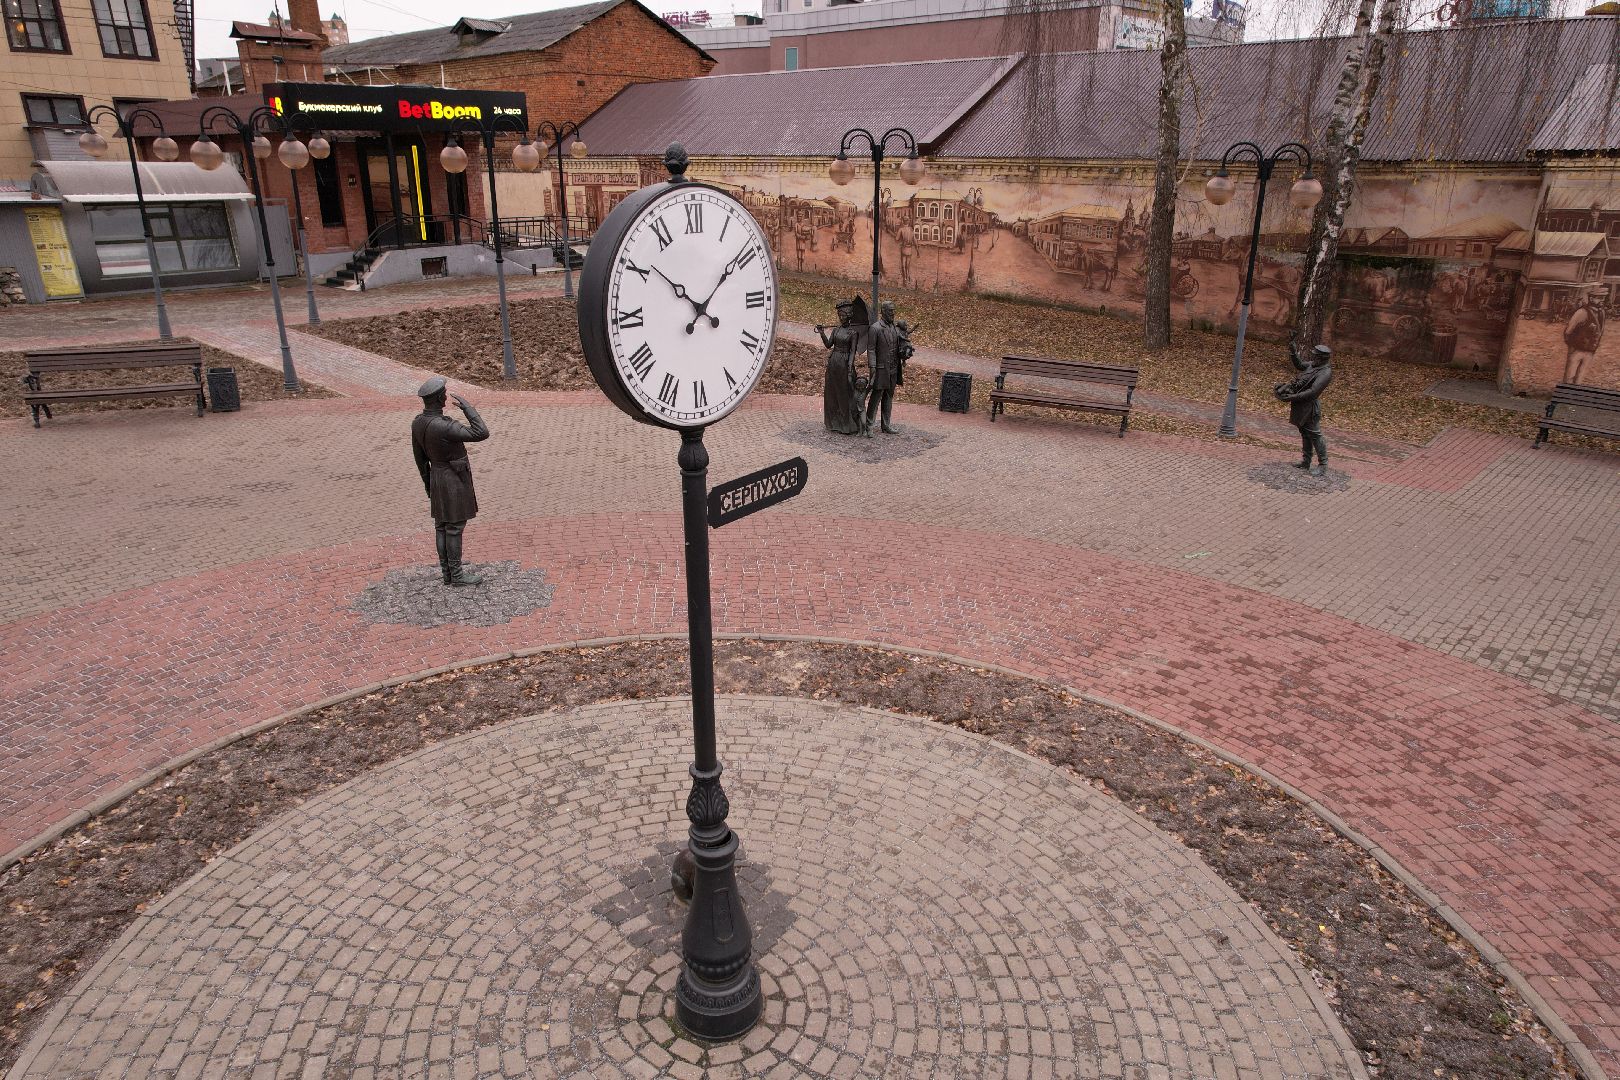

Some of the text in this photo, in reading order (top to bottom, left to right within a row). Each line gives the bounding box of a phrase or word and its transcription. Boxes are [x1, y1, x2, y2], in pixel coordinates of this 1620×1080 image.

[298, 101, 383, 114] Букмекерский клуб
[398, 99, 482, 119] BetBoom
[493, 105, 521, 115] 24 часа
[684, 204, 703, 234] XII
[719, 215, 731, 242] I
[649, 216, 673, 252] XI
[626, 259, 650, 283] X
[737, 247, 756, 270] II
[745, 290, 764, 309] III
[619, 307, 643, 329] IX
[740, 329, 759, 355] IV
[628, 341, 657, 382] VIII
[657, 372, 680, 408] VII
[723, 366, 737, 390] V
[693, 380, 708, 409] VI
[720, 466, 798, 513] СЕРПУХОВ
